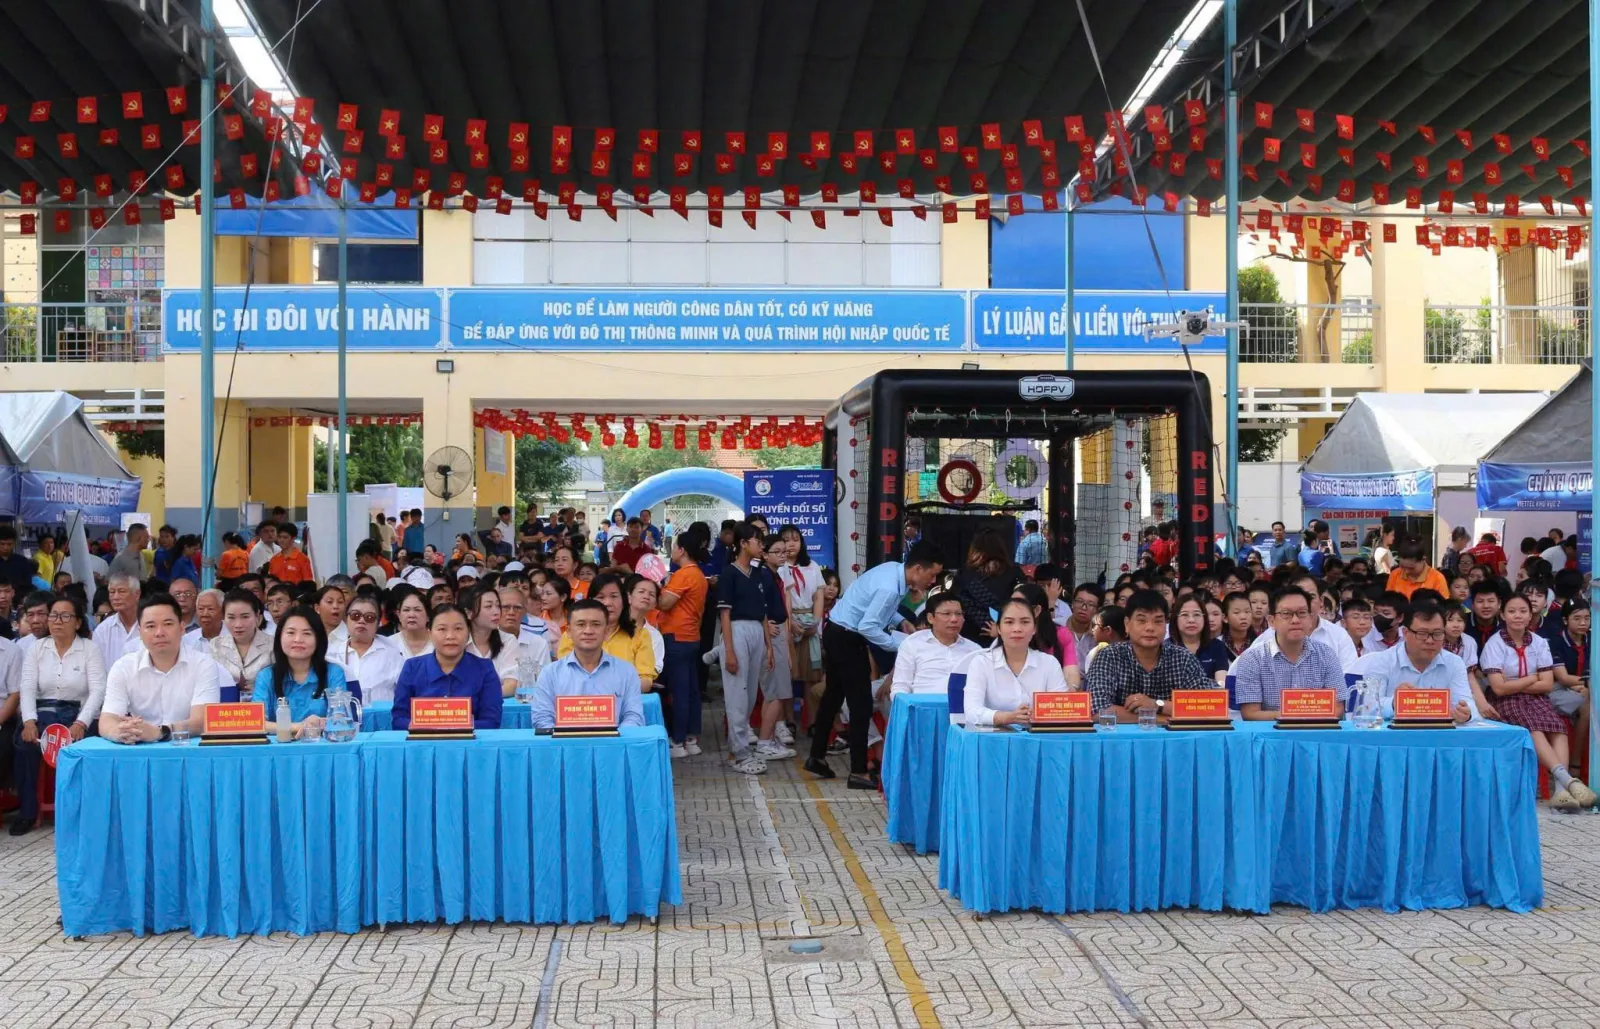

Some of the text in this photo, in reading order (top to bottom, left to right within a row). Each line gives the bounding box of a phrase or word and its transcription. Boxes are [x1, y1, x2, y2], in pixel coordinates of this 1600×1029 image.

[543, 297, 873, 318] HỌC ĐỂ LÀM NGƯỜI CÔNG DÂN TỐT, CÓ KỸ NĂNG
[177, 303, 430, 337] HỌC ĐI ĐÔI VỚI HÀNH
[463, 320, 951, 344] ĐỂ ĐÁP ỨNG VỚI ĐÔ THỊ THÔNG MINH VÀ QUÁ TRÌNH HỘI NHẬP QUỐC TẾ
[983, 305, 1001, 335] LÝ
[1005, 306, 1045, 341] LUẬN
[1085, 304, 1119, 336] LIỀN
[1122, 307, 1147, 336] VỚI
[44, 477, 122, 507] CHÍNH QUYỀN SỐ
[1310, 477, 1338, 495] KHÔNG
[1340, 480, 1360, 497] GIAN
[1527, 469, 1593, 495] CHÍNH QUY
[751, 502, 826, 514] CHUYỂN ĐỔI SỐ
[767, 515, 829, 525] ƯỜNG CÁT LÁI
